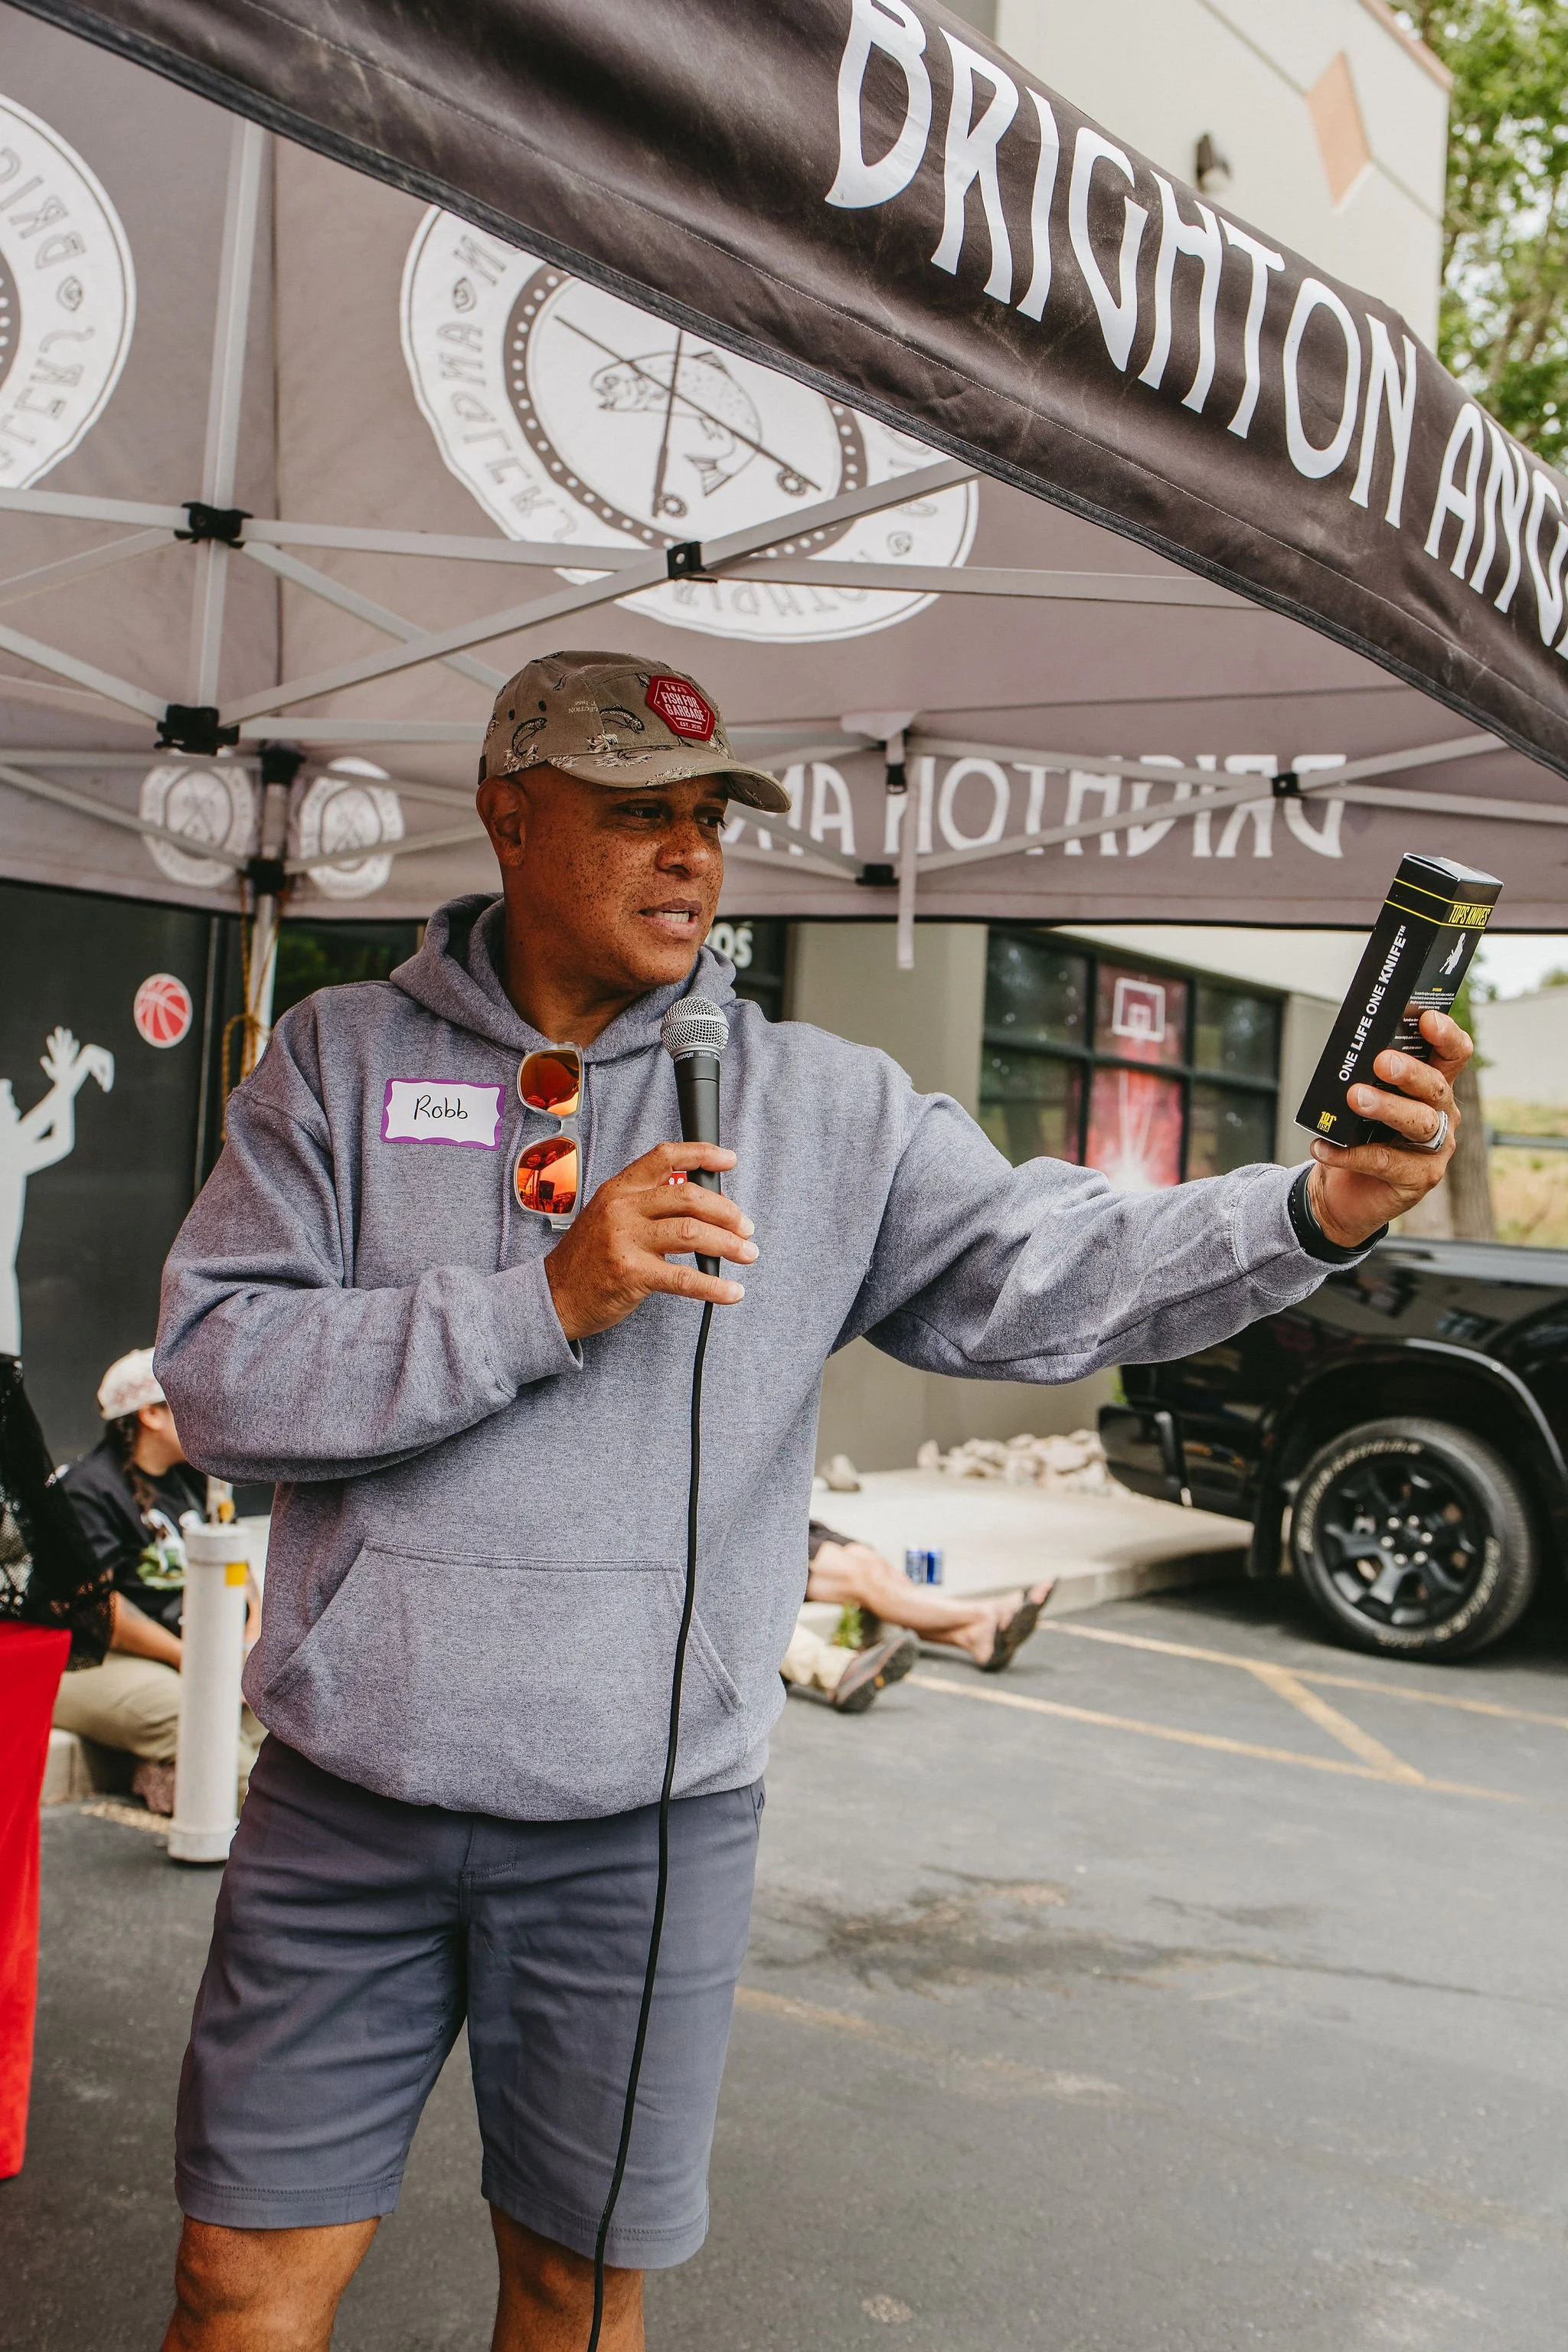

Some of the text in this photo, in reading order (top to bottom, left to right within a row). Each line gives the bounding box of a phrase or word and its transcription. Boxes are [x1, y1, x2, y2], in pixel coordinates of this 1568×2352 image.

[825, 0, 1568, 662] BRIGHTON ANG
[661, 692, 700, 709] FISH FOR
[665, 704, 706, 722] GARBAGE
[1448, 904, 1491, 926] TOPS KNIVES
[1338, 1050, 1358, 1081] ONE
[1351, 1016, 1373, 1050] LIFE
[1366, 984, 1387, 1015] ONE
[414, 1095, 468, 1120] Robb
[1318, 1121, 1330, 1132] USA
